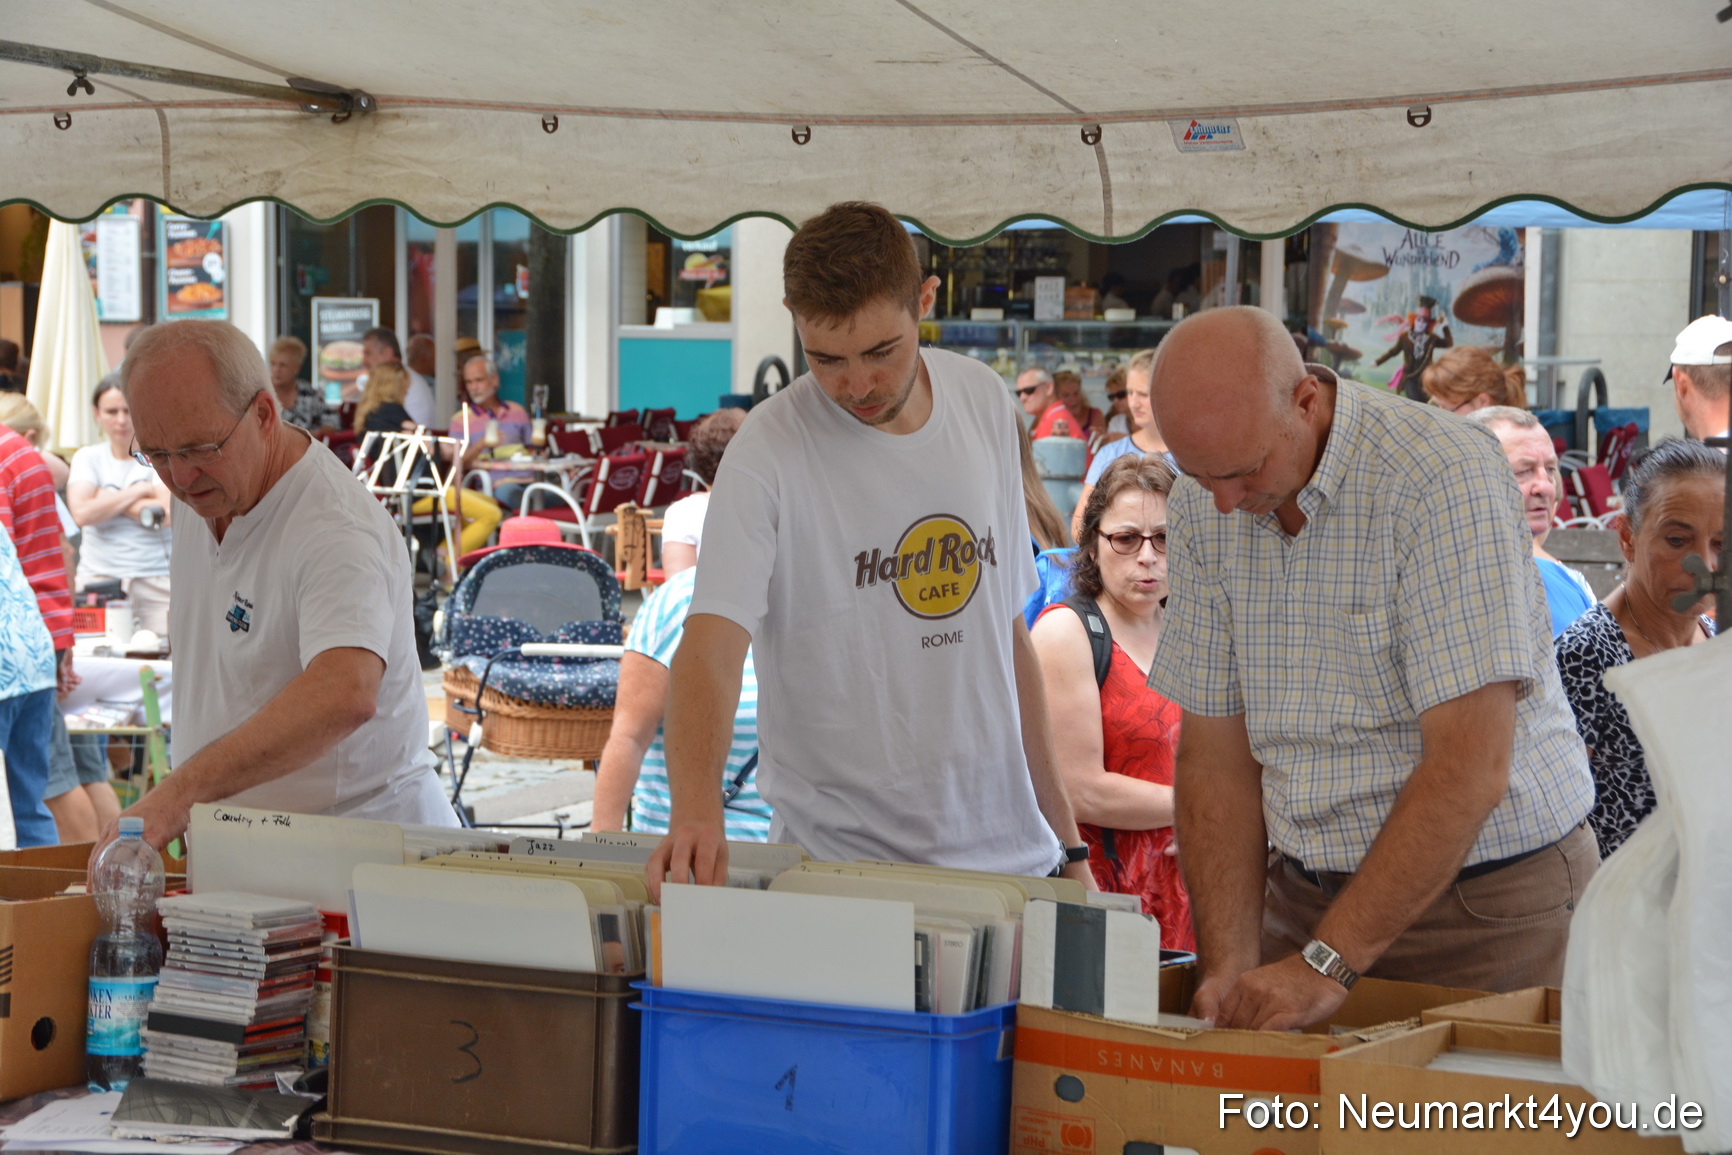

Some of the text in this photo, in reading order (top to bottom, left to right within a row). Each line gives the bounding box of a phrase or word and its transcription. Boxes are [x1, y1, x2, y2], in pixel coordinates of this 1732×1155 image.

[854, 526, 998, 589] Hard Rock
[919, 582, 960, 601] CAFE
[921, 630, 964, 649] ROME
[213, 808, 253, 829] Country
[272, 814, 292, 828] Folk
[526, 839, 556, 855] Jazz
[449, 1020, 483, 1083] 3
[1097, 1049, 1224, 1079] BANANES
[775, 1064, 798, 1112] 1
